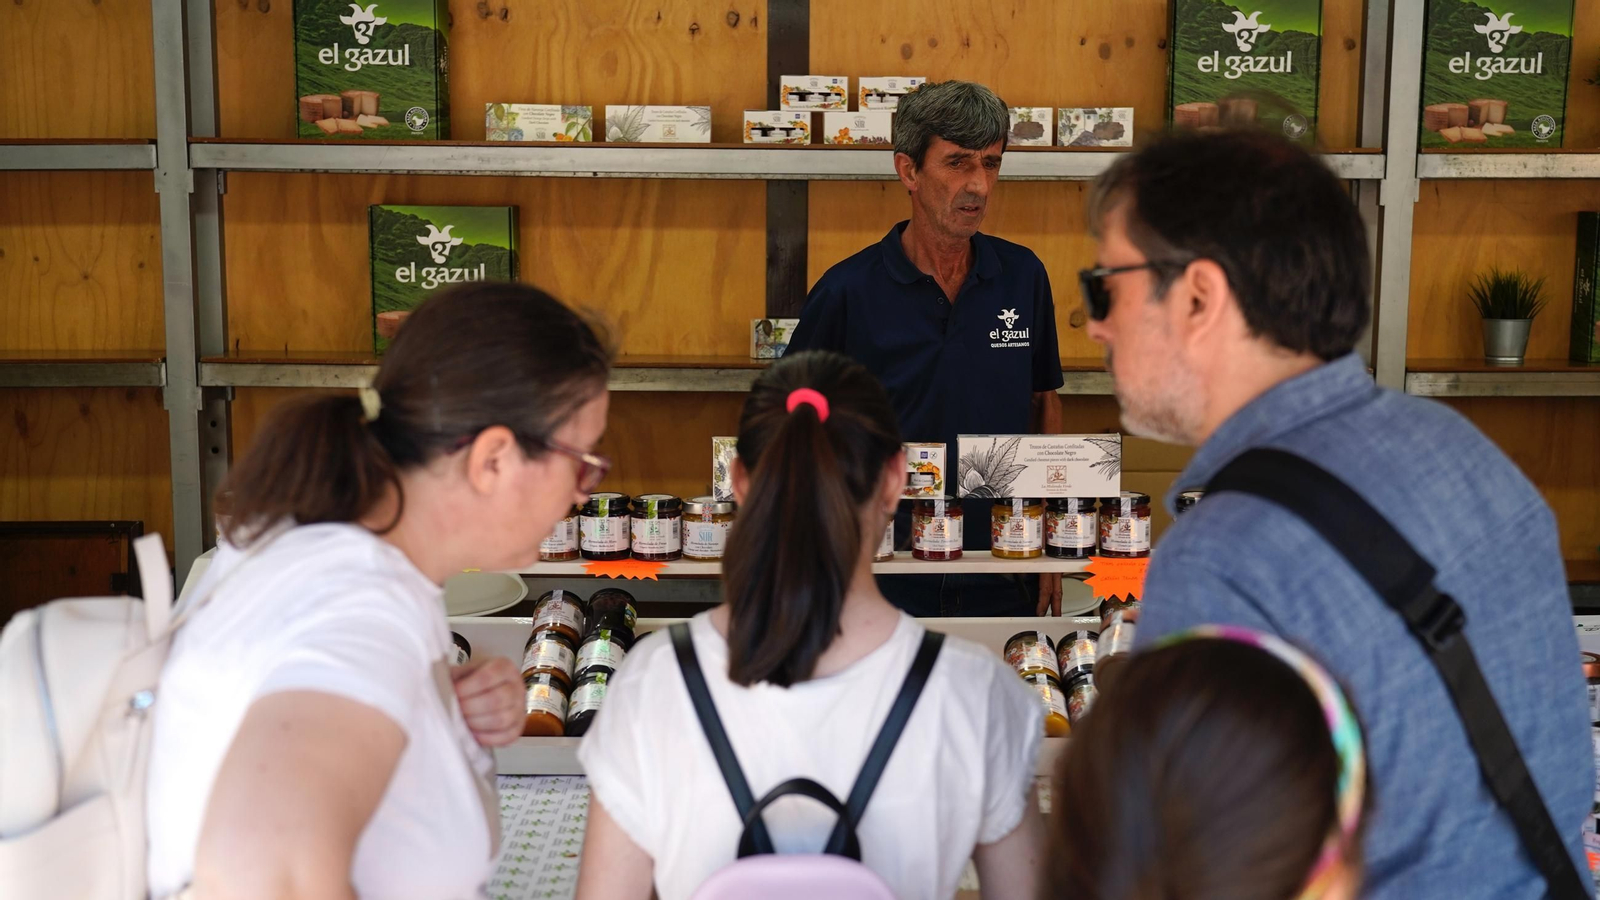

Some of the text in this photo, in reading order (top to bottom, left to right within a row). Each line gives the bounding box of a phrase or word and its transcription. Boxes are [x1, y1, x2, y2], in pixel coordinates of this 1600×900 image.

[318, 43, 410, 72] el gazul
[1197, 50, 1292, 79] el gazul
[1448, 51, 1543, 80] el gazul
[396, 262, 486, 290] el gazul
[990, 328, 1030, 342] el gazul
[699, 532, 713, 542] SUR
